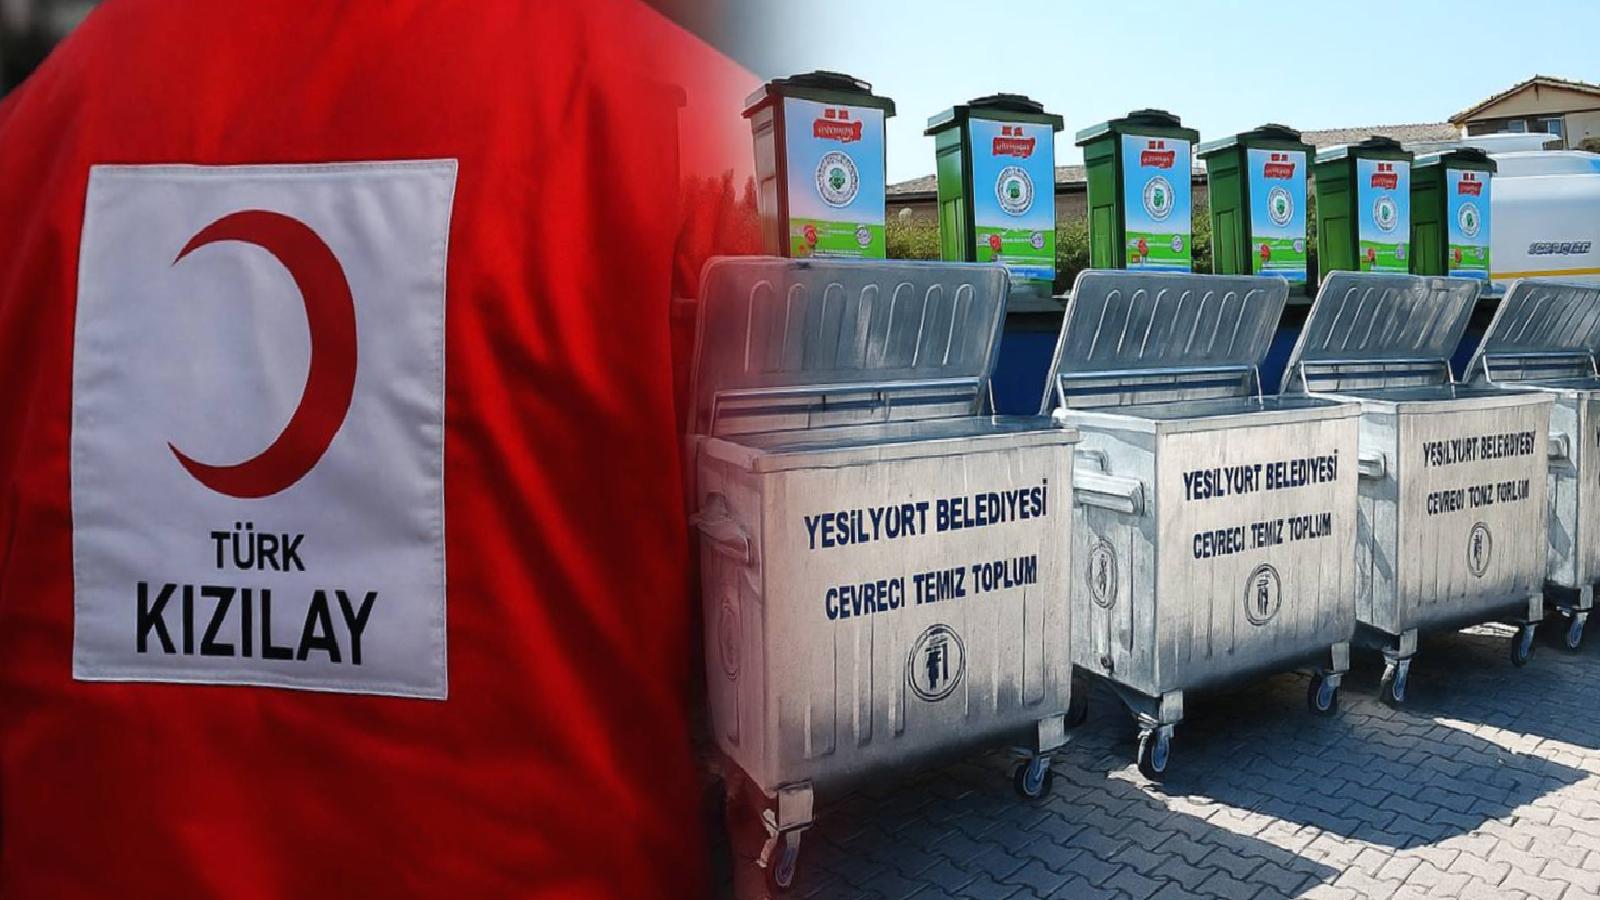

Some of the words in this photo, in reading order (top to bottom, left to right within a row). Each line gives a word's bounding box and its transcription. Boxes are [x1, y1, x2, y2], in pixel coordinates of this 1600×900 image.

[210, 521, 305, 572] TÜRK
[1288, 512, 1332, 541] TOPLUM
[825, 577, 905, 620] CEVRECI
[913, 566, 966, 604] TEMIZ
[972, 555, 1037, 593] TOPLUM
[136, 581, 378, 665] KIZILAY
